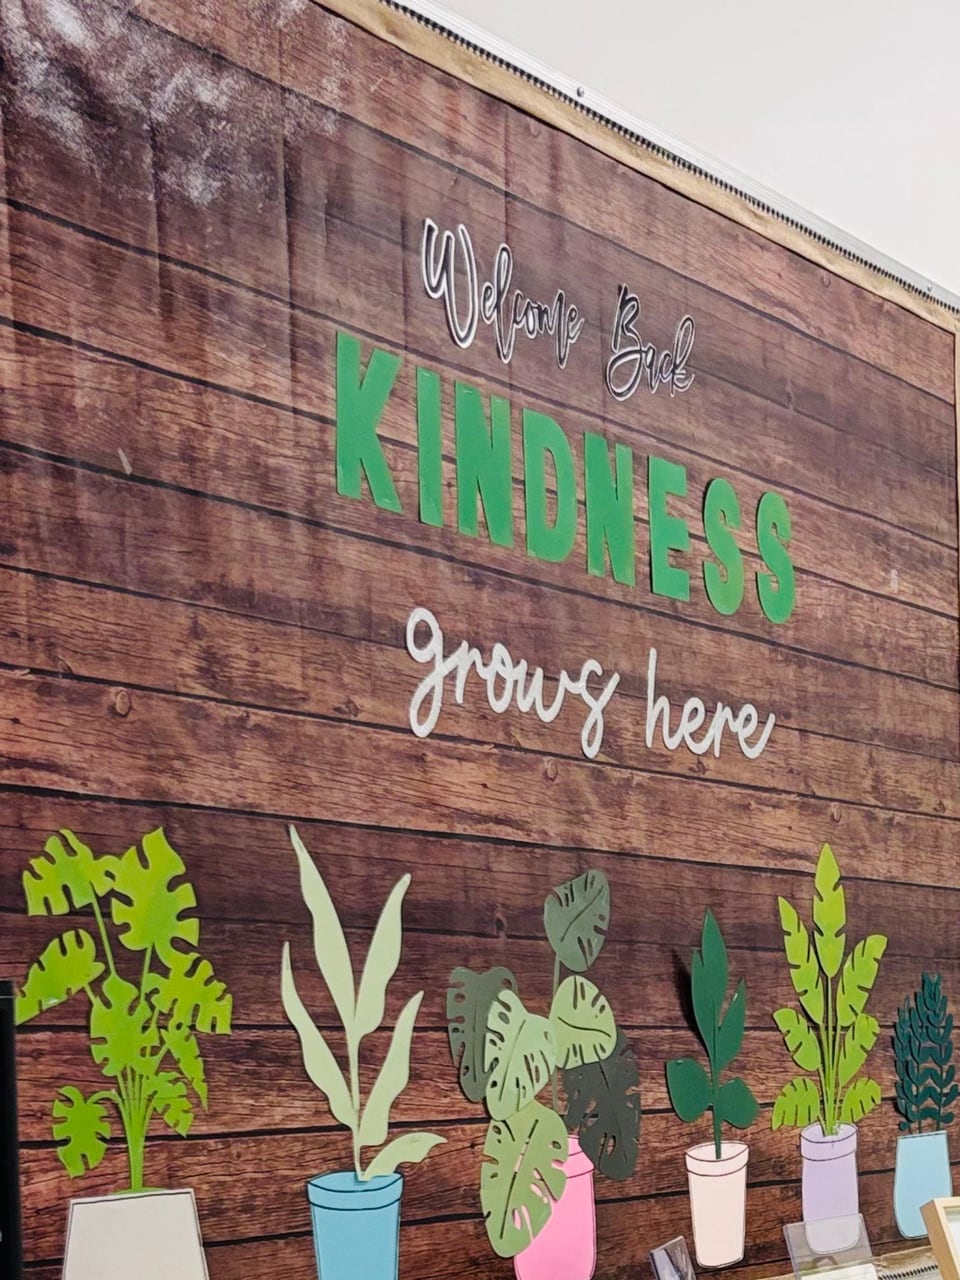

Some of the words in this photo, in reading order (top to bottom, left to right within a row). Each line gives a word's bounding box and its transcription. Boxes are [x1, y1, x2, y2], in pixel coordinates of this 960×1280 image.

[421, 218, 585, 369] Welcome
[605, 283, 695, 401] Back
[335, 330, 796, 624] KINDNESS
[405, 606, 621, 759] grows
[645, 647, 777, 760] here
